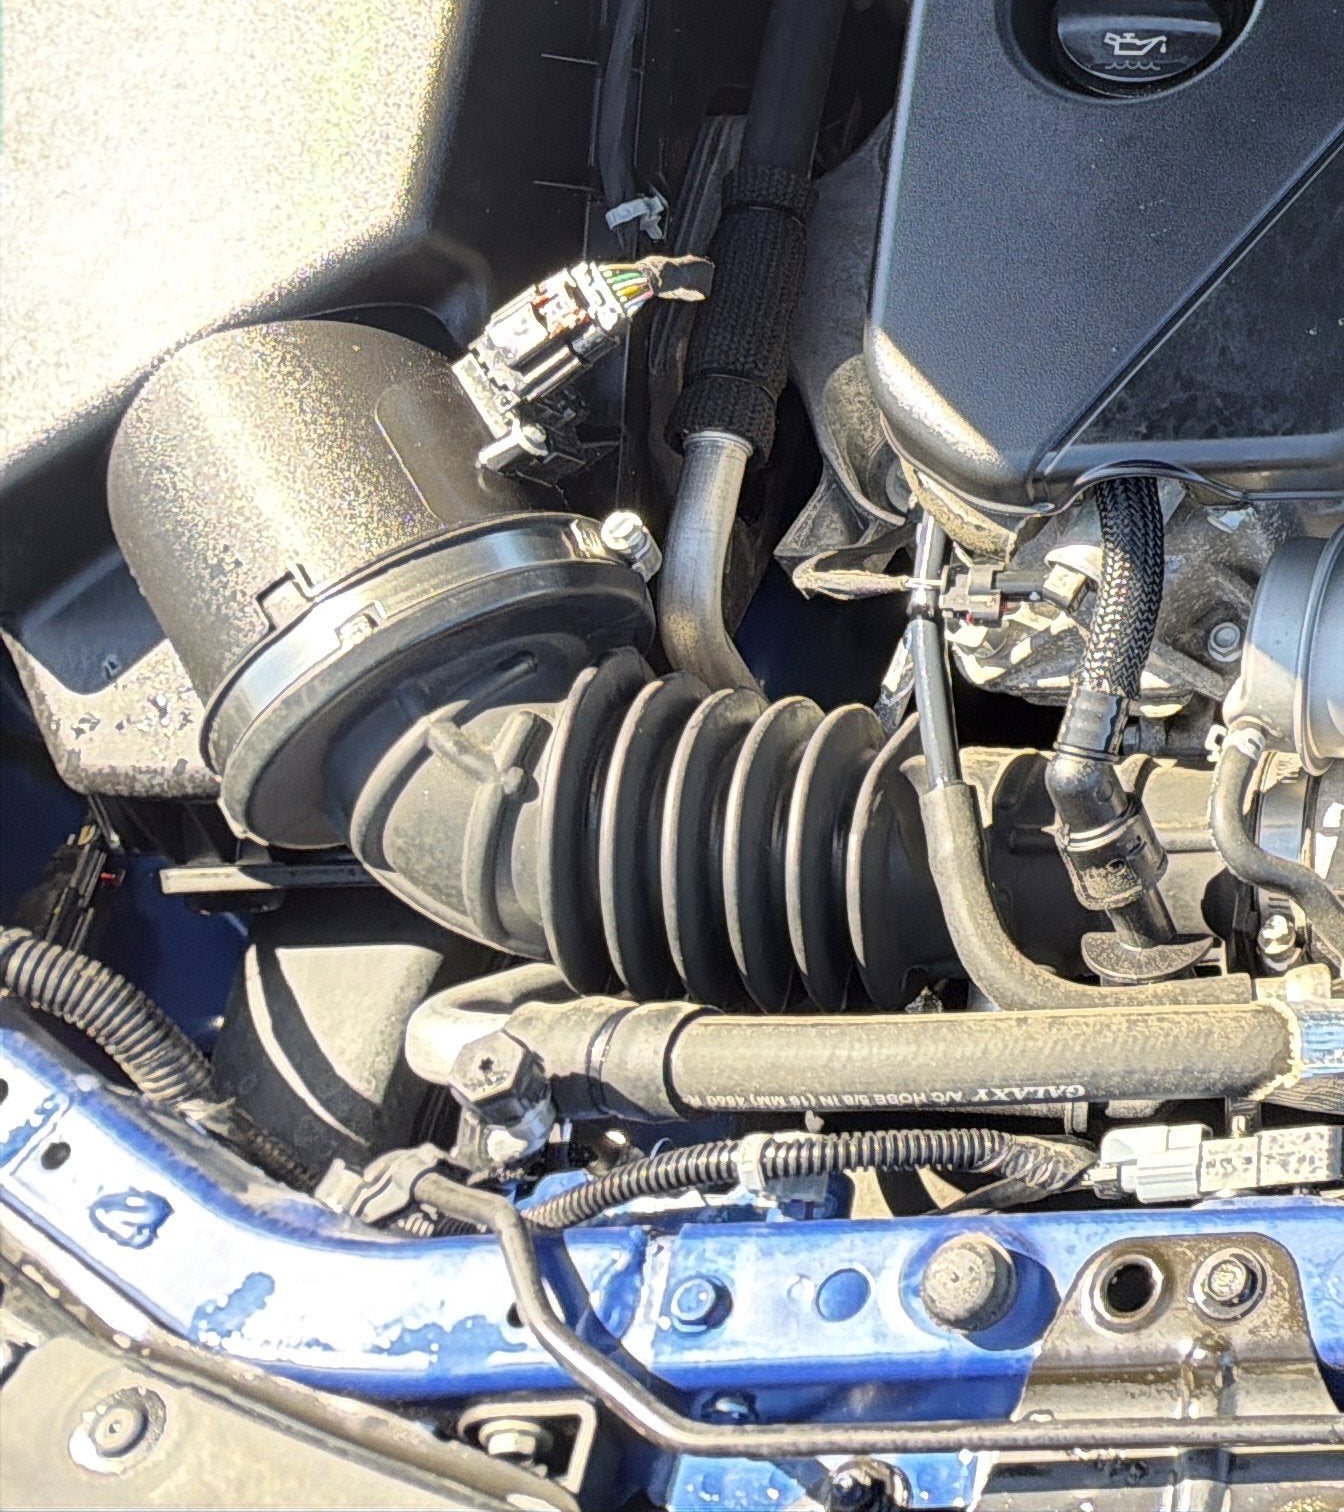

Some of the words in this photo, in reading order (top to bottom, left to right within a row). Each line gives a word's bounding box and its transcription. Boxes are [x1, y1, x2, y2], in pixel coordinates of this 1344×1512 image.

[873, 1092, 927, 1107] HOSE
[931, 1090, 962, 1104] A/C
[971, 1084, 1085, 1101] GALAXY
[749, 1093, 786, 1107] MM)
[819, 1094, 838, 1107] IN
[843, 1093, 871, 1107] 5/8
